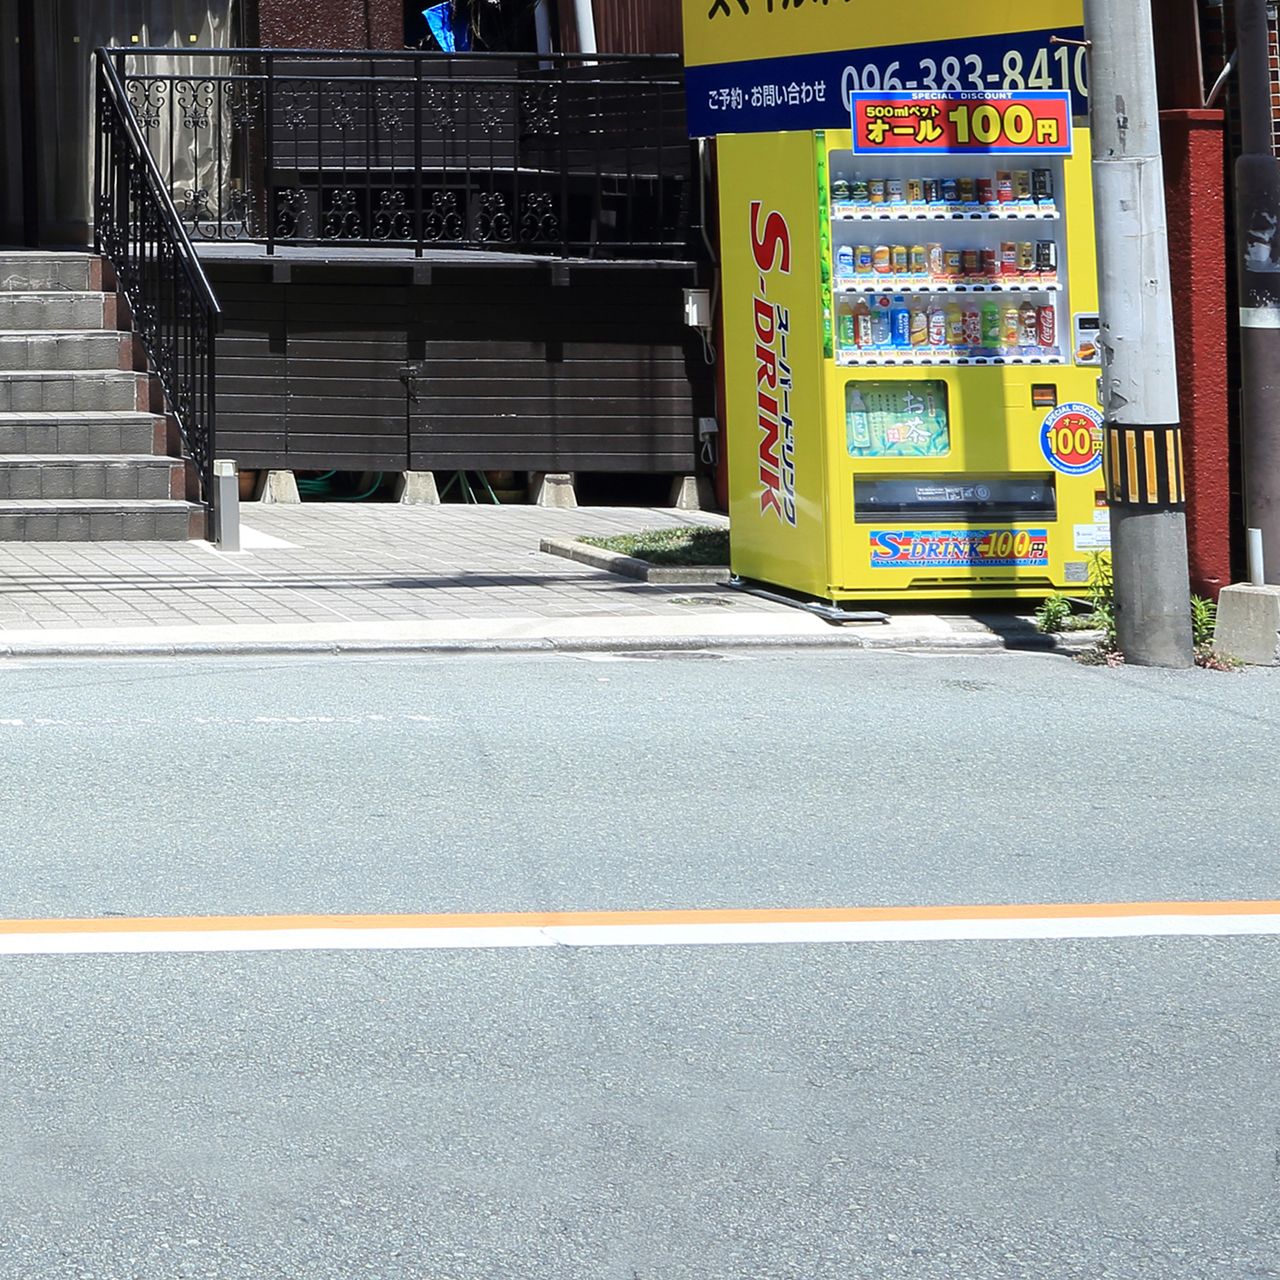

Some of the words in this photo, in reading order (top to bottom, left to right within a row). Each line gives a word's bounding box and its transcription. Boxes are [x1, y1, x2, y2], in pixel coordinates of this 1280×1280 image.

[708, 80, 827, 111] ご予約・お問い合わせ
[911, 91, 954, 100] SPECIAL
[960, 91, 1013, 100] DISCOUNT
[866, 104, 940, 118] 500mlペット
[867, 118, 943, 144] オール
[948, 104, 1060, 145] 100円
[750, 201, 791, 519] S-DRINK
[776, 304, 797, 528] スーパードリンク
[902, 390, 932, 444] お茶
[1045, 405, 1071, 426] SPECIAL
[1072, 405, 1103, 428] DISCOUN
[1063, 417, 1087, 427] オール
[871, 531, 984, 560] S-DRINK
[984, 530, 1046, 559] 100円
